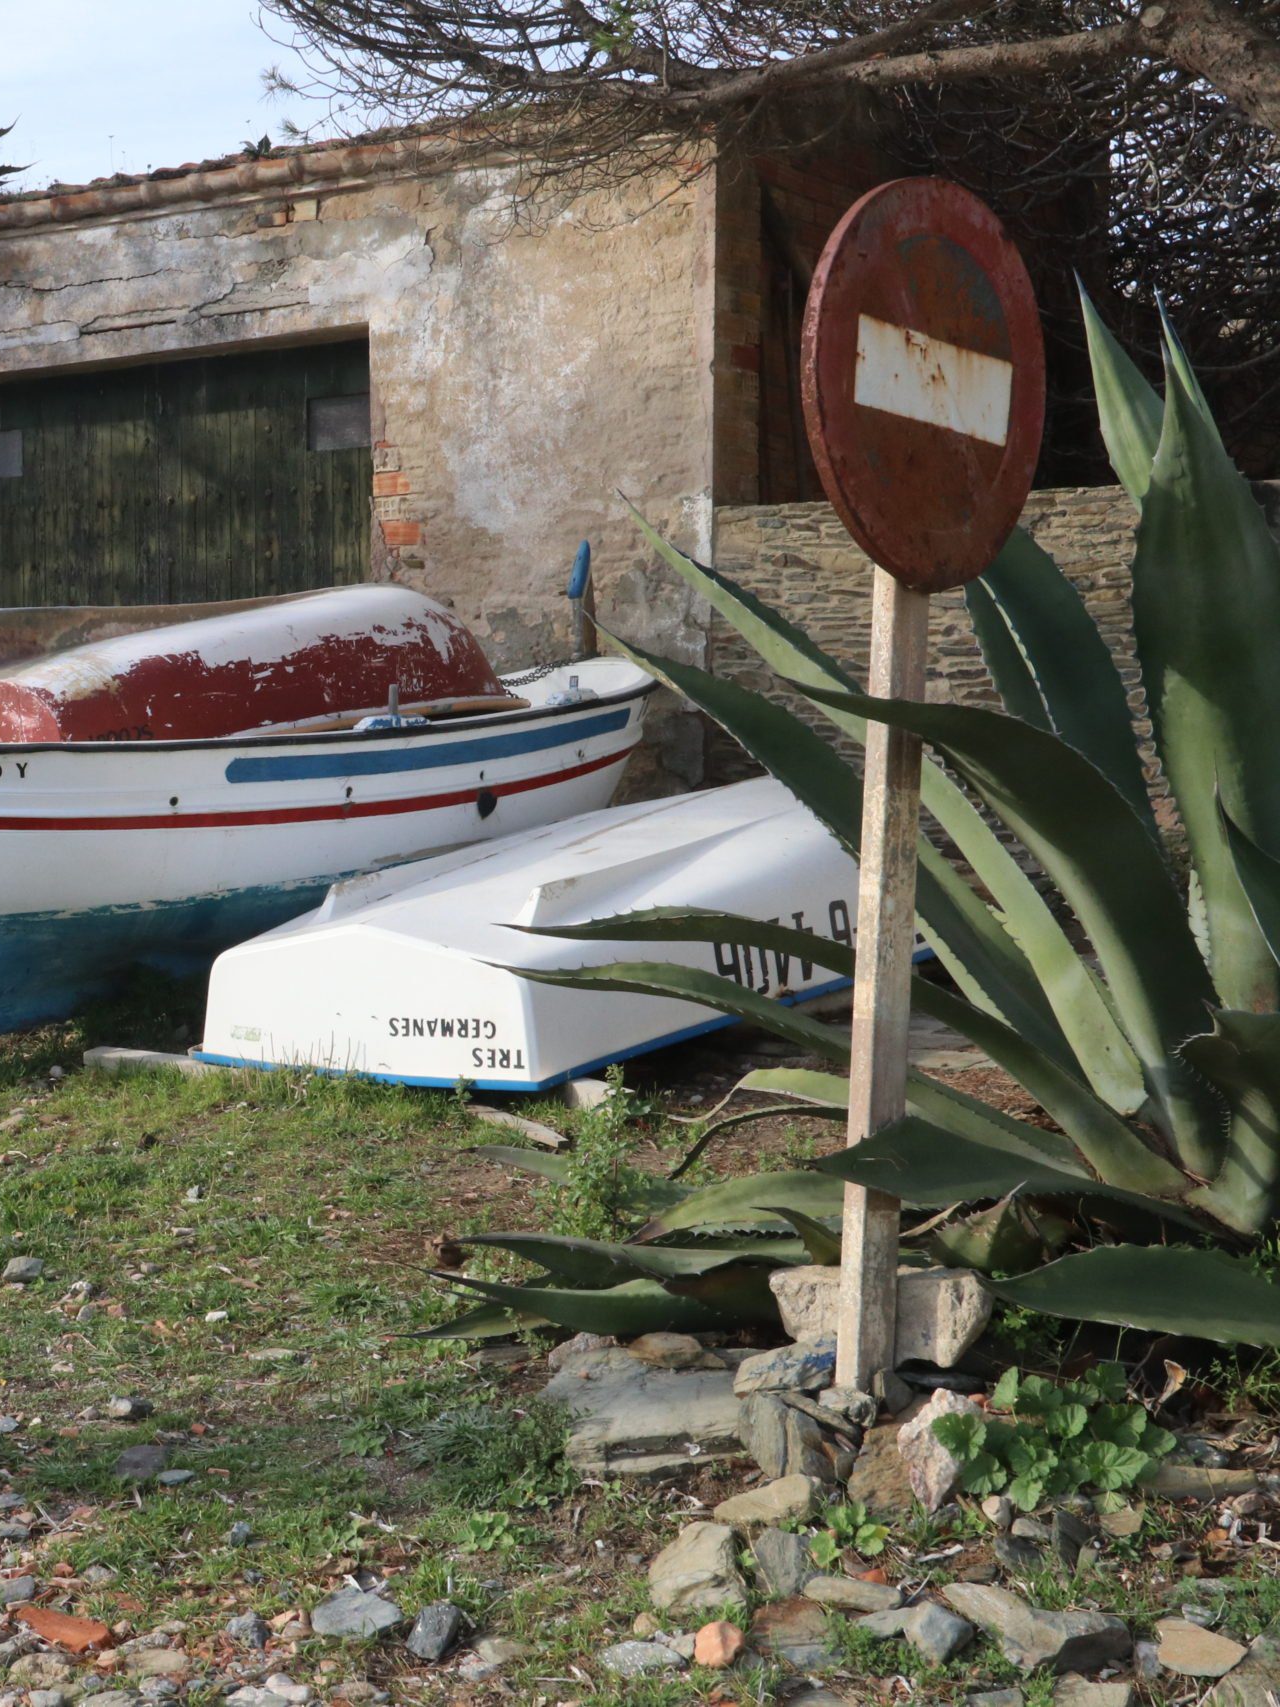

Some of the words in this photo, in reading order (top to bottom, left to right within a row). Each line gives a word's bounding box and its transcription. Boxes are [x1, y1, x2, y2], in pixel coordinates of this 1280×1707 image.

[16, 762, 28, 779] Y
[388, 1017, 497, 1040] GERMANES
[472, 1047, 525, 1069] TRES
